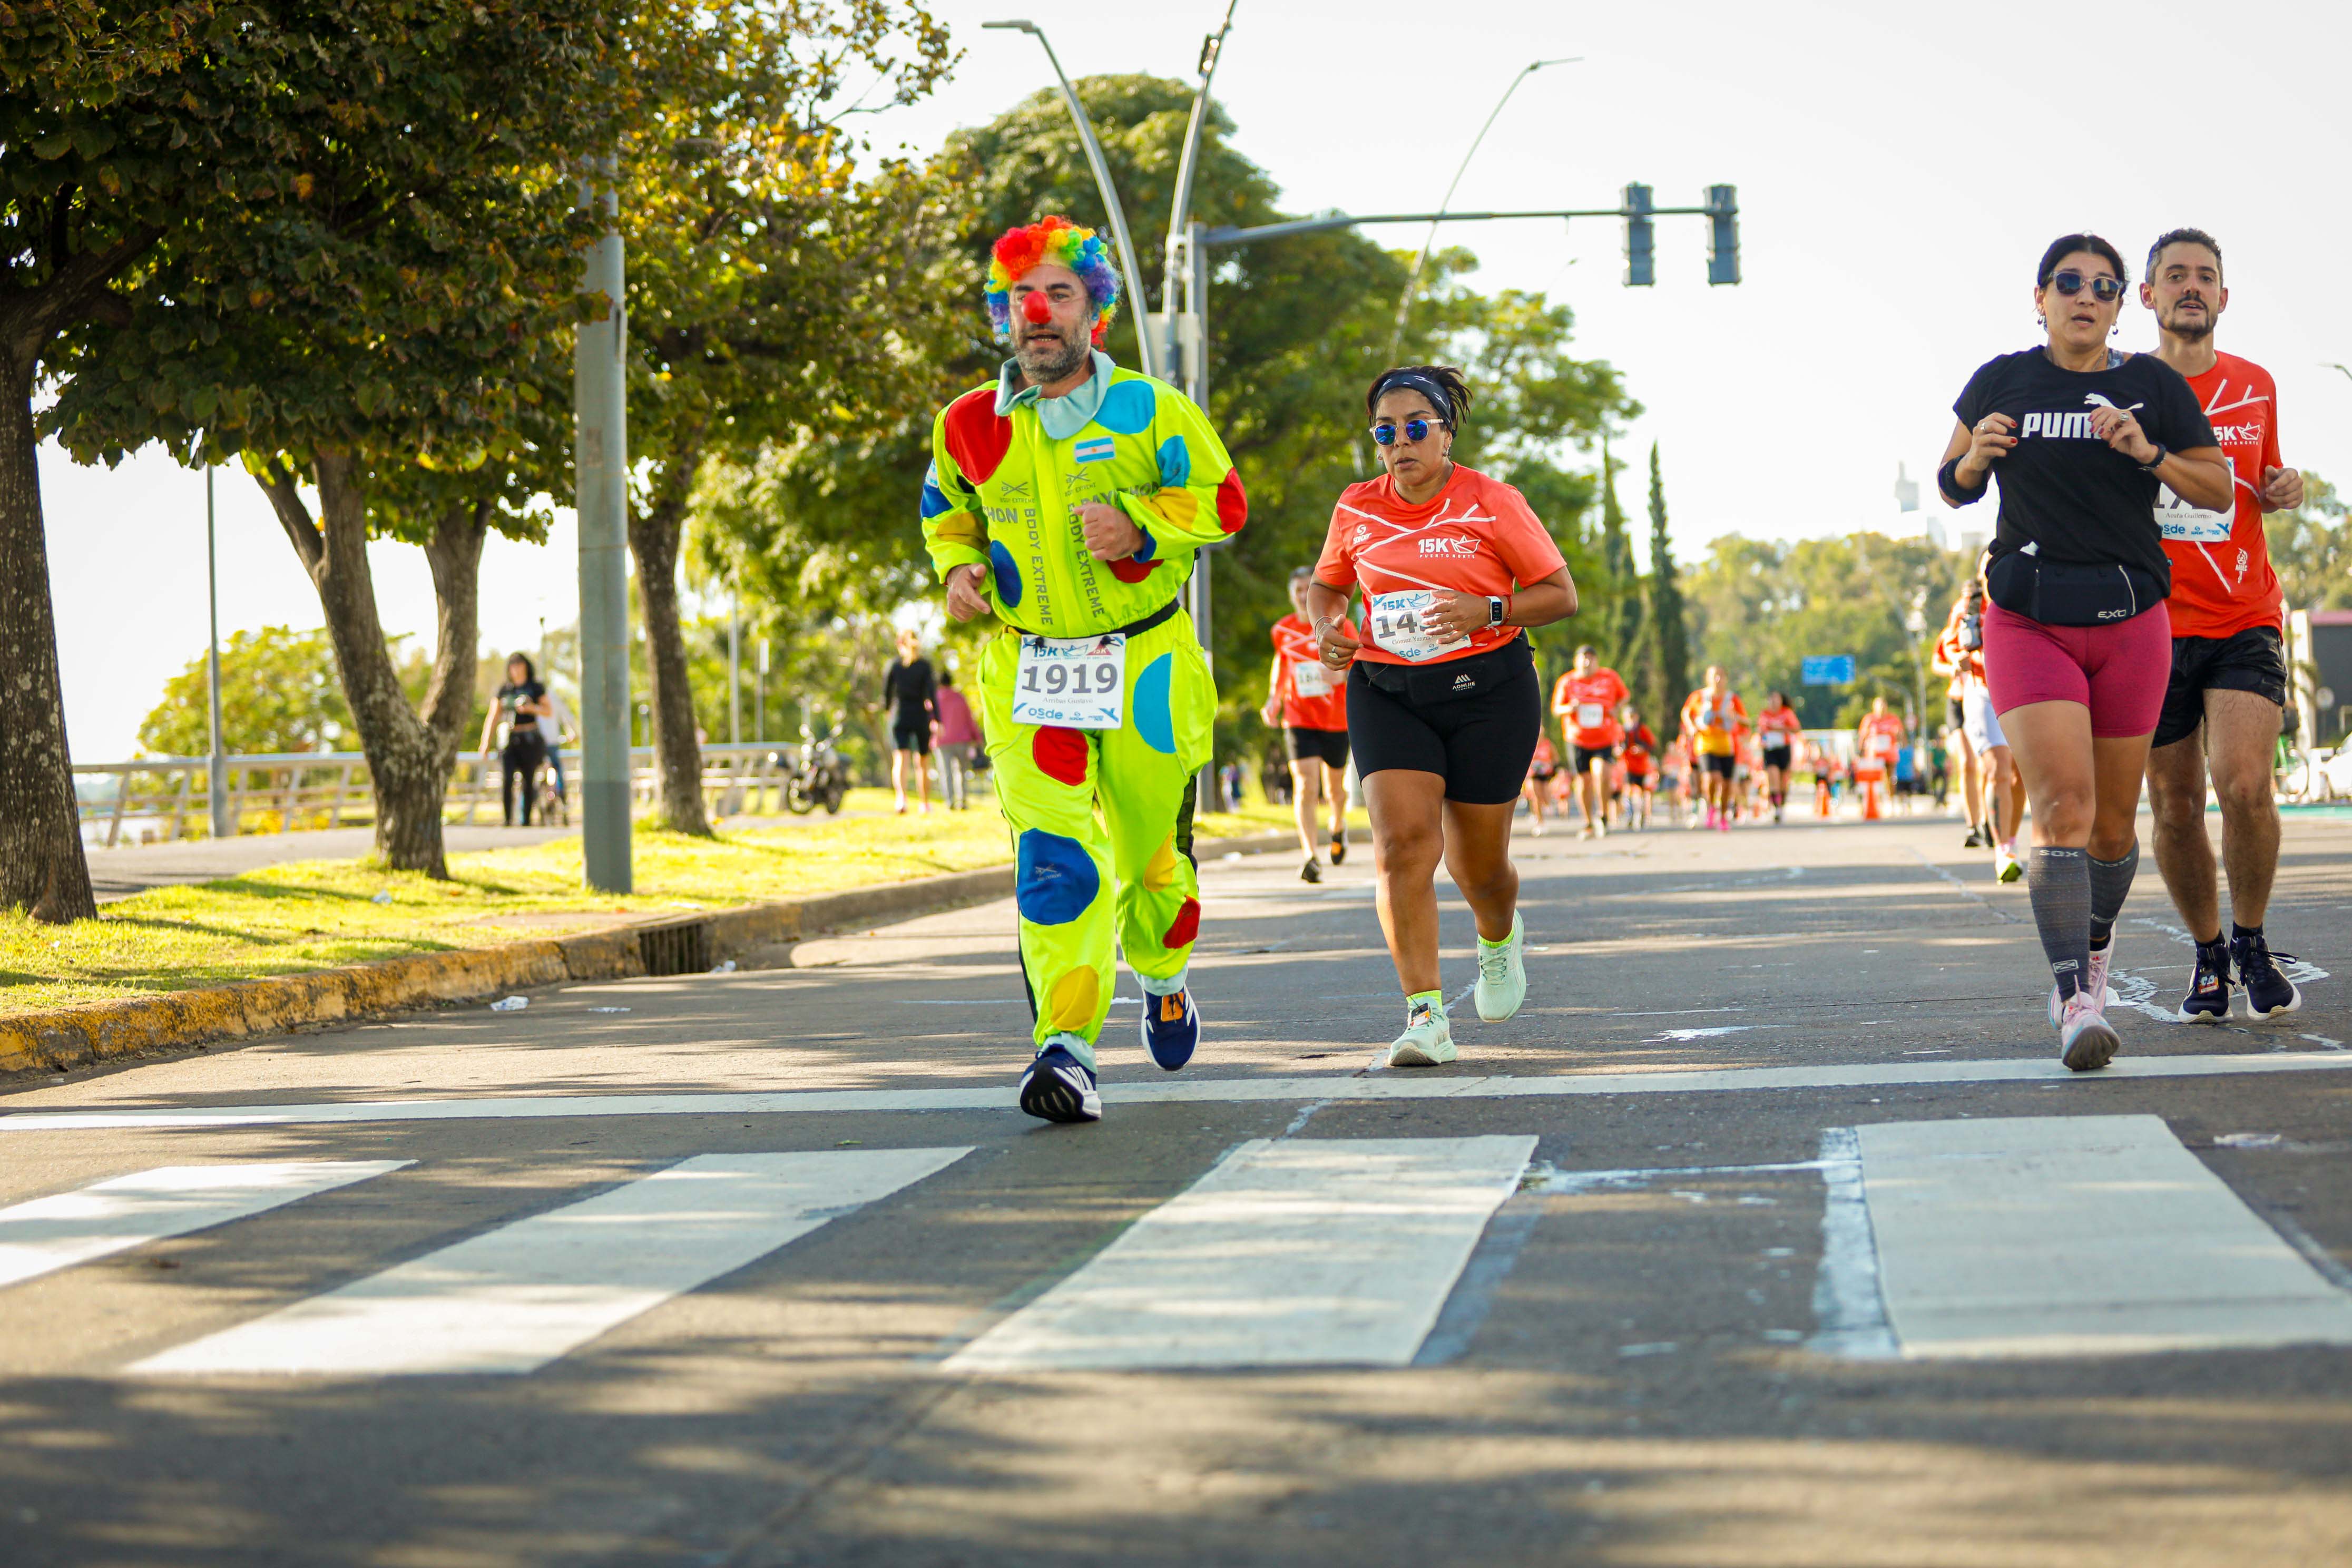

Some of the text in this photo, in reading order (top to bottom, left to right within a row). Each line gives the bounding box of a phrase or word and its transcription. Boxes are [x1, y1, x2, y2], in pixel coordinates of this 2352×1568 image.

[2021, 413, 2101, 439] PUM
[2210, 426, 2237, 442] 5K
[983, 506, 1018, 523] HON
[2160, 523, 2186, 534] sde
[1418, 538, 1449, 553] 15K
[1024, 508, 1054, 625] BODY EXTREME
[1076, 550, 1105, 618] EXTREME
[1382, 599, 1405, 611] 15K
[2098, 609, 2126, 619] EXO
[1033, 644, 1059, 658] 15K
[1022, 663, 1118, 694] 1919
[1028, 708, 1063, 720] osde
